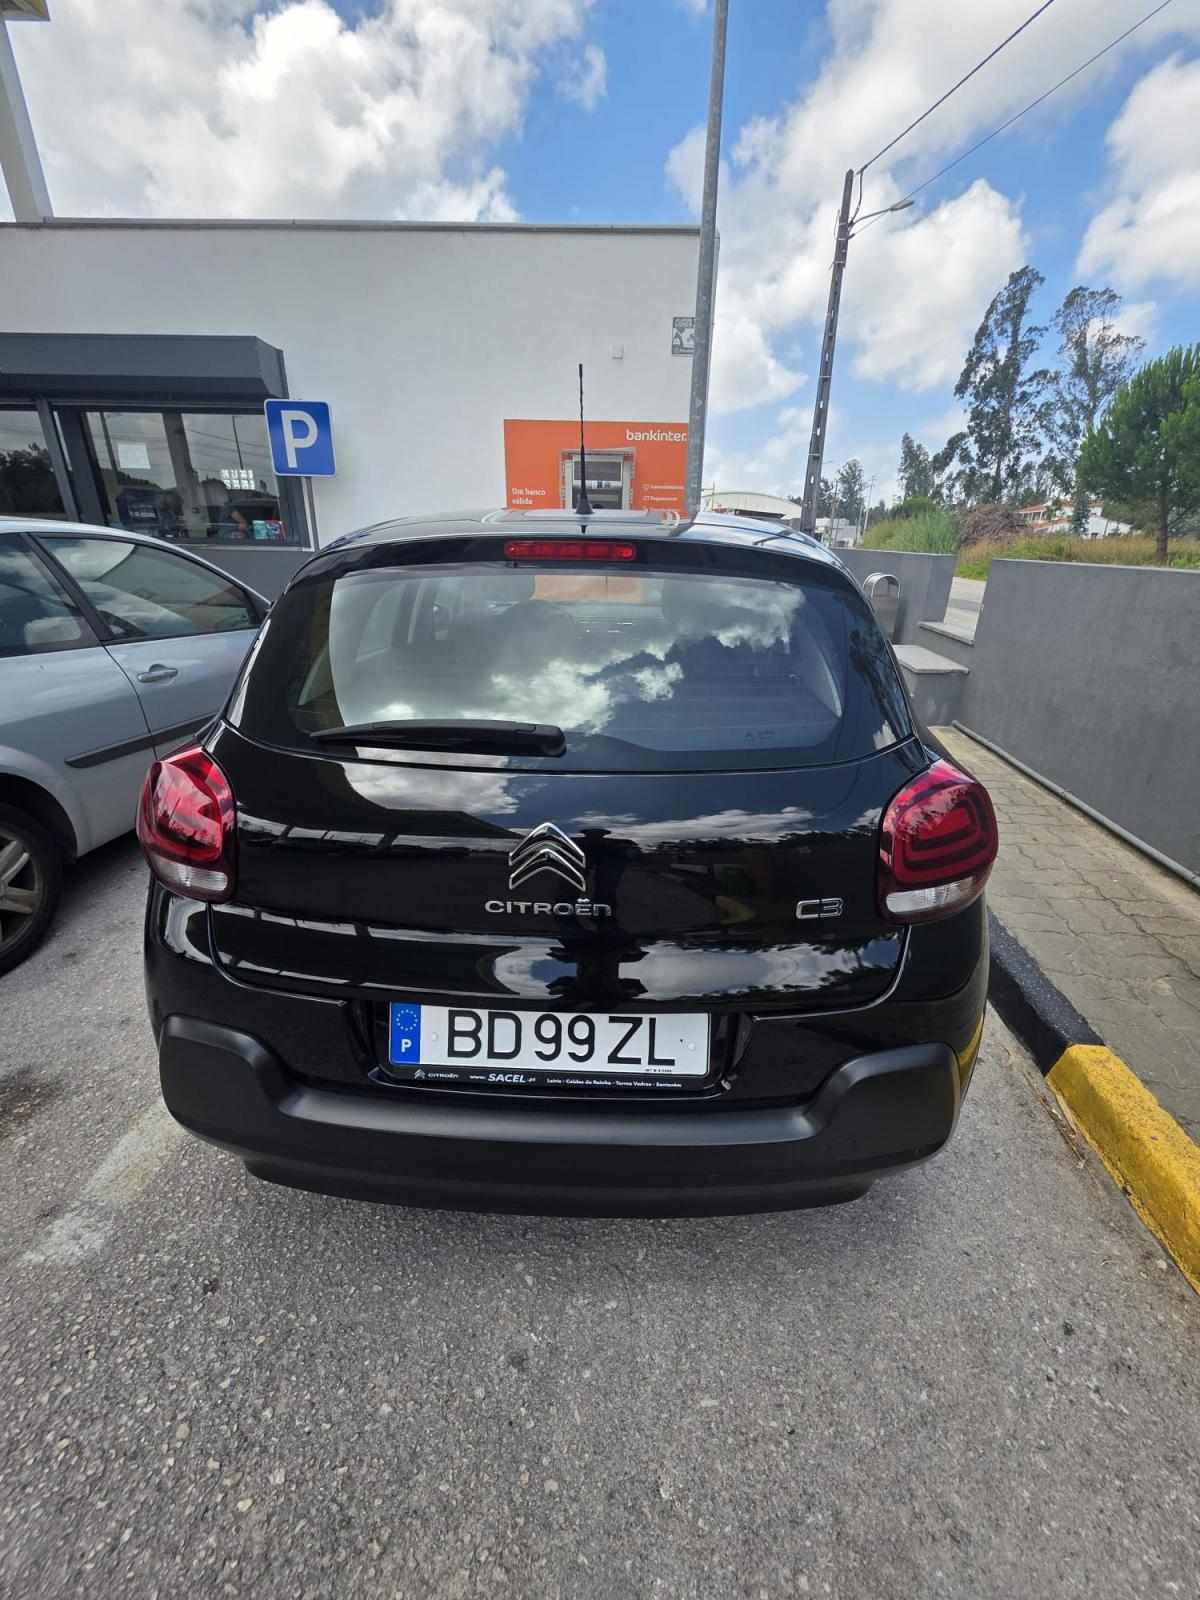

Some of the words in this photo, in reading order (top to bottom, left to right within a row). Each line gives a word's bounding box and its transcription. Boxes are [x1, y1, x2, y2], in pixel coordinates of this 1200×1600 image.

[280, 409, 318, 469] P
[796, 897, 844, 919] C3
[401, 1038, 412, 1053] P
[447, 1009, 522, 1060] BD
[534, 1013, 596, 1063] 99
[607, 1015, 676, 1066] ZL
